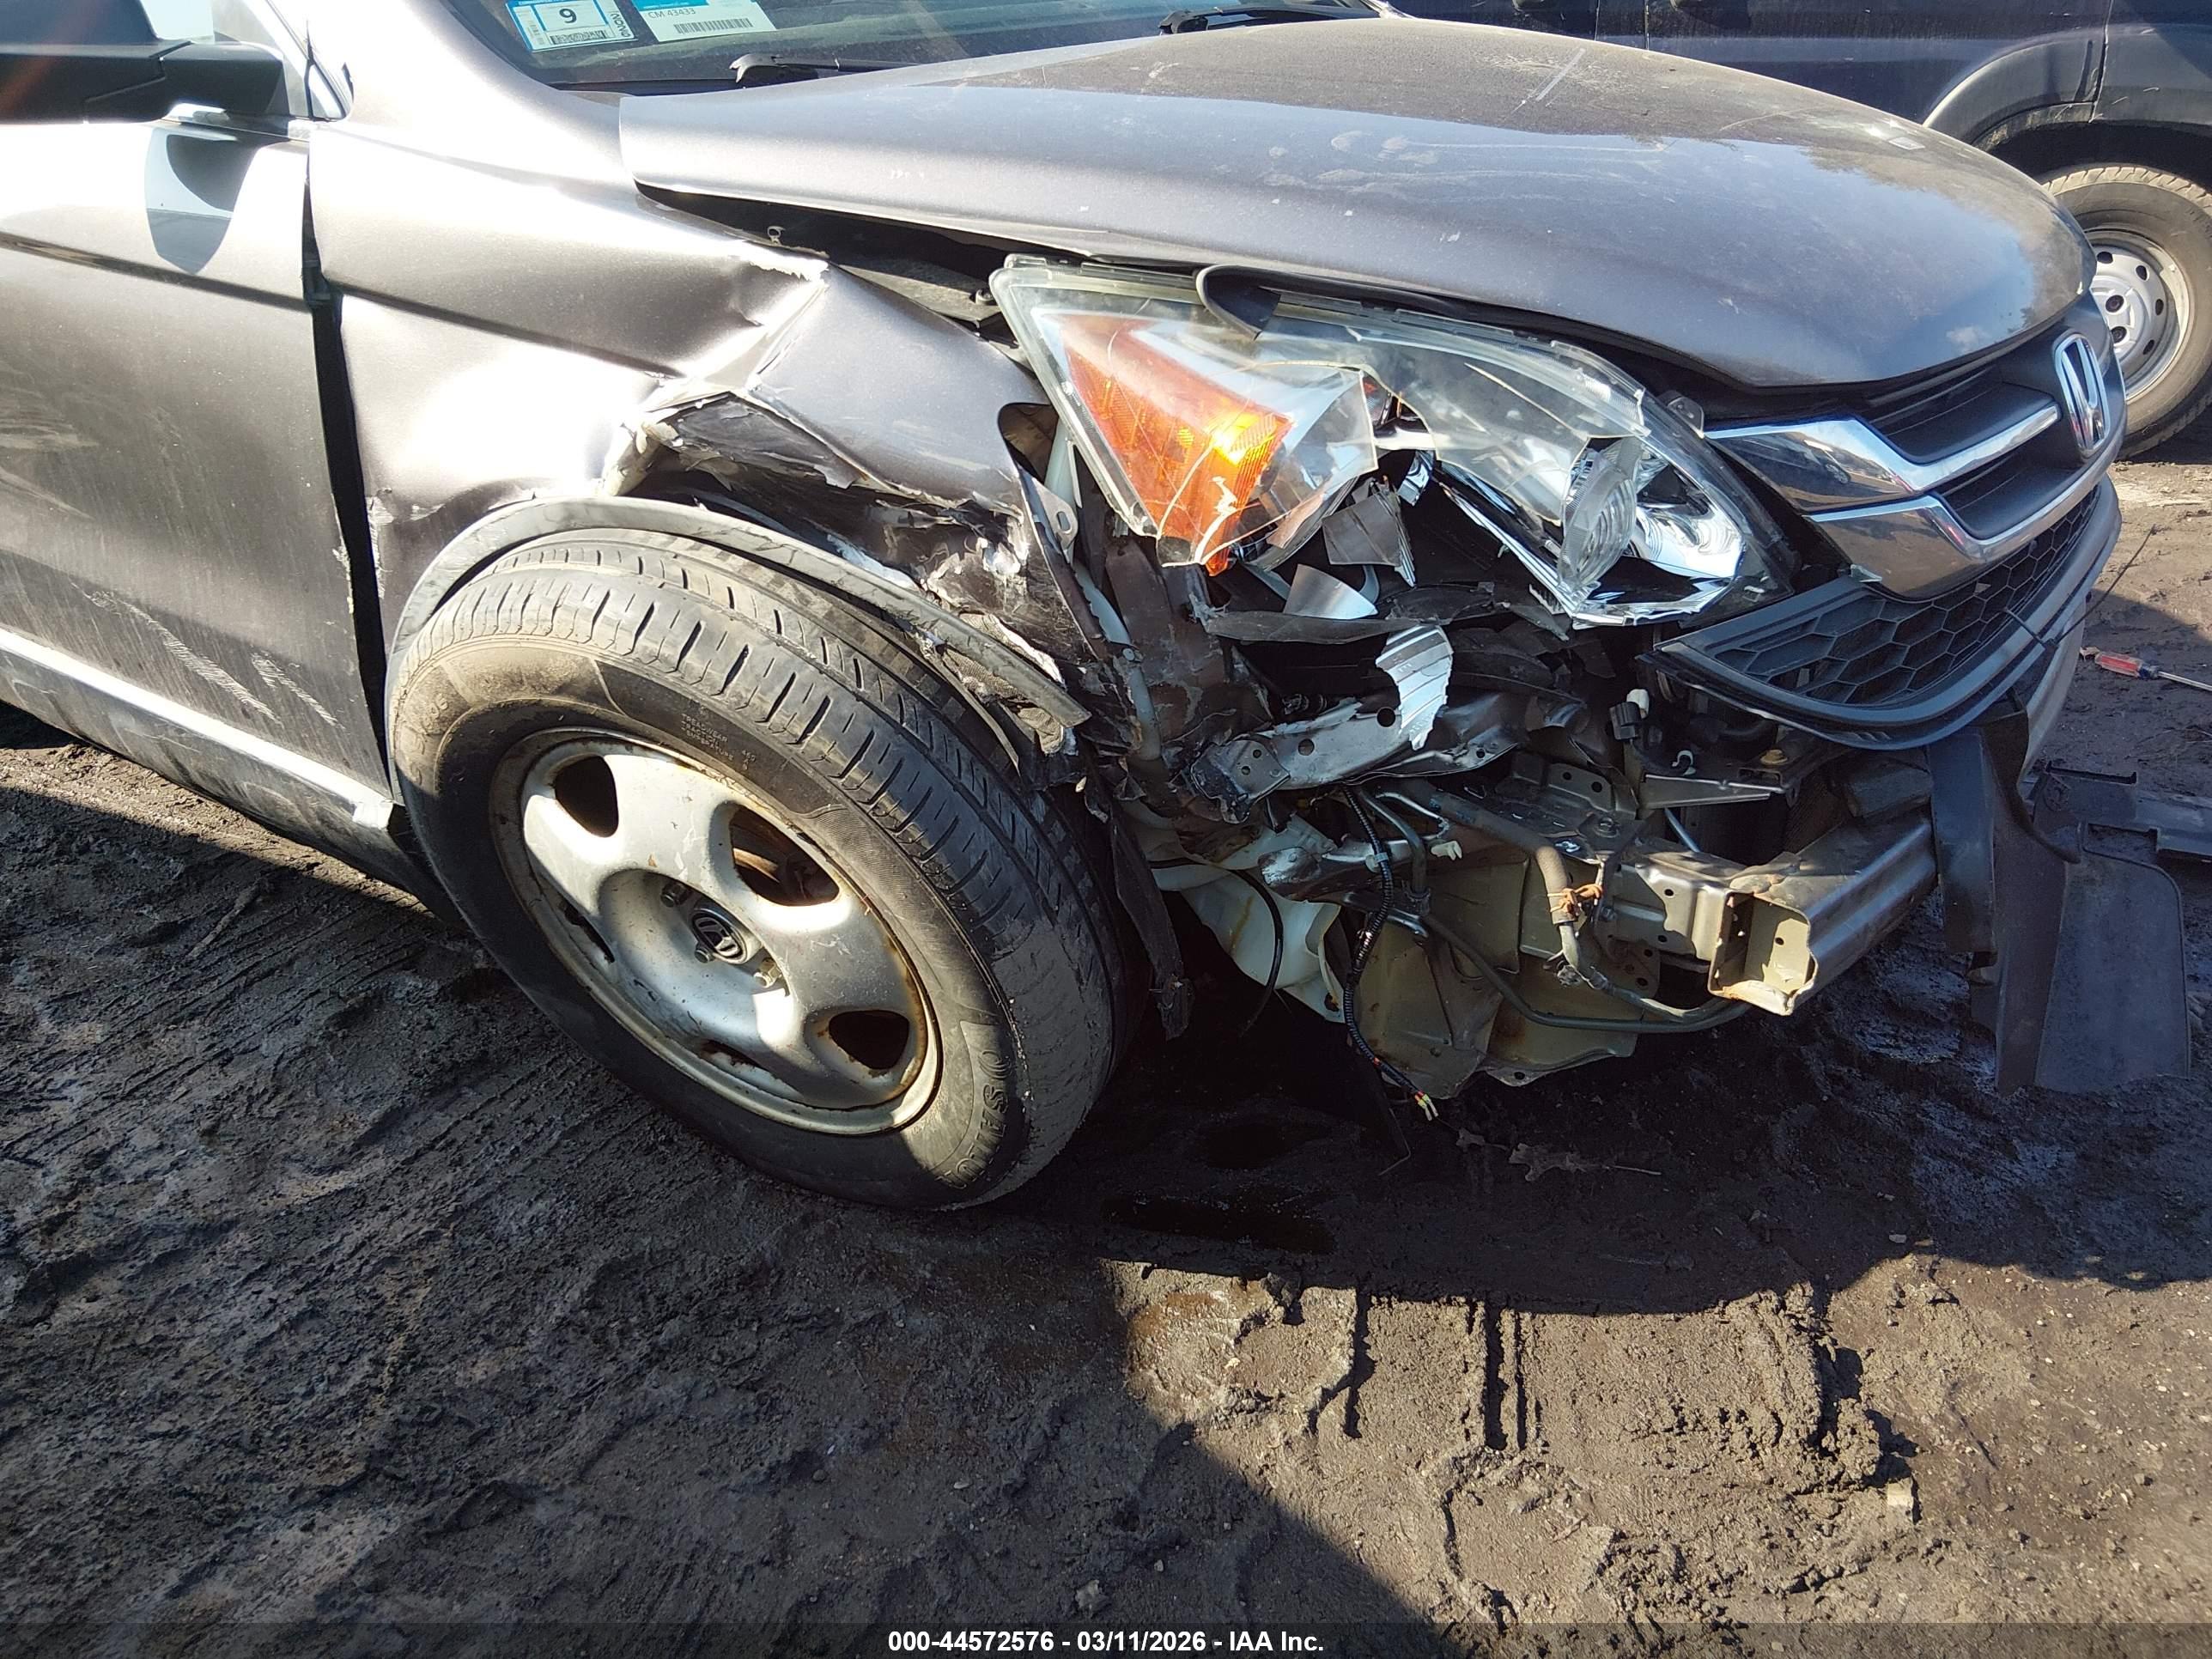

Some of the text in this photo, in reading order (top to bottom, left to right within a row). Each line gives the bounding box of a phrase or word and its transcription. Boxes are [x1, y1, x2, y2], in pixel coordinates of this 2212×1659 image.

[558, 8, 577, 24] 9
[647, 7, 696, 19] CM 43433
